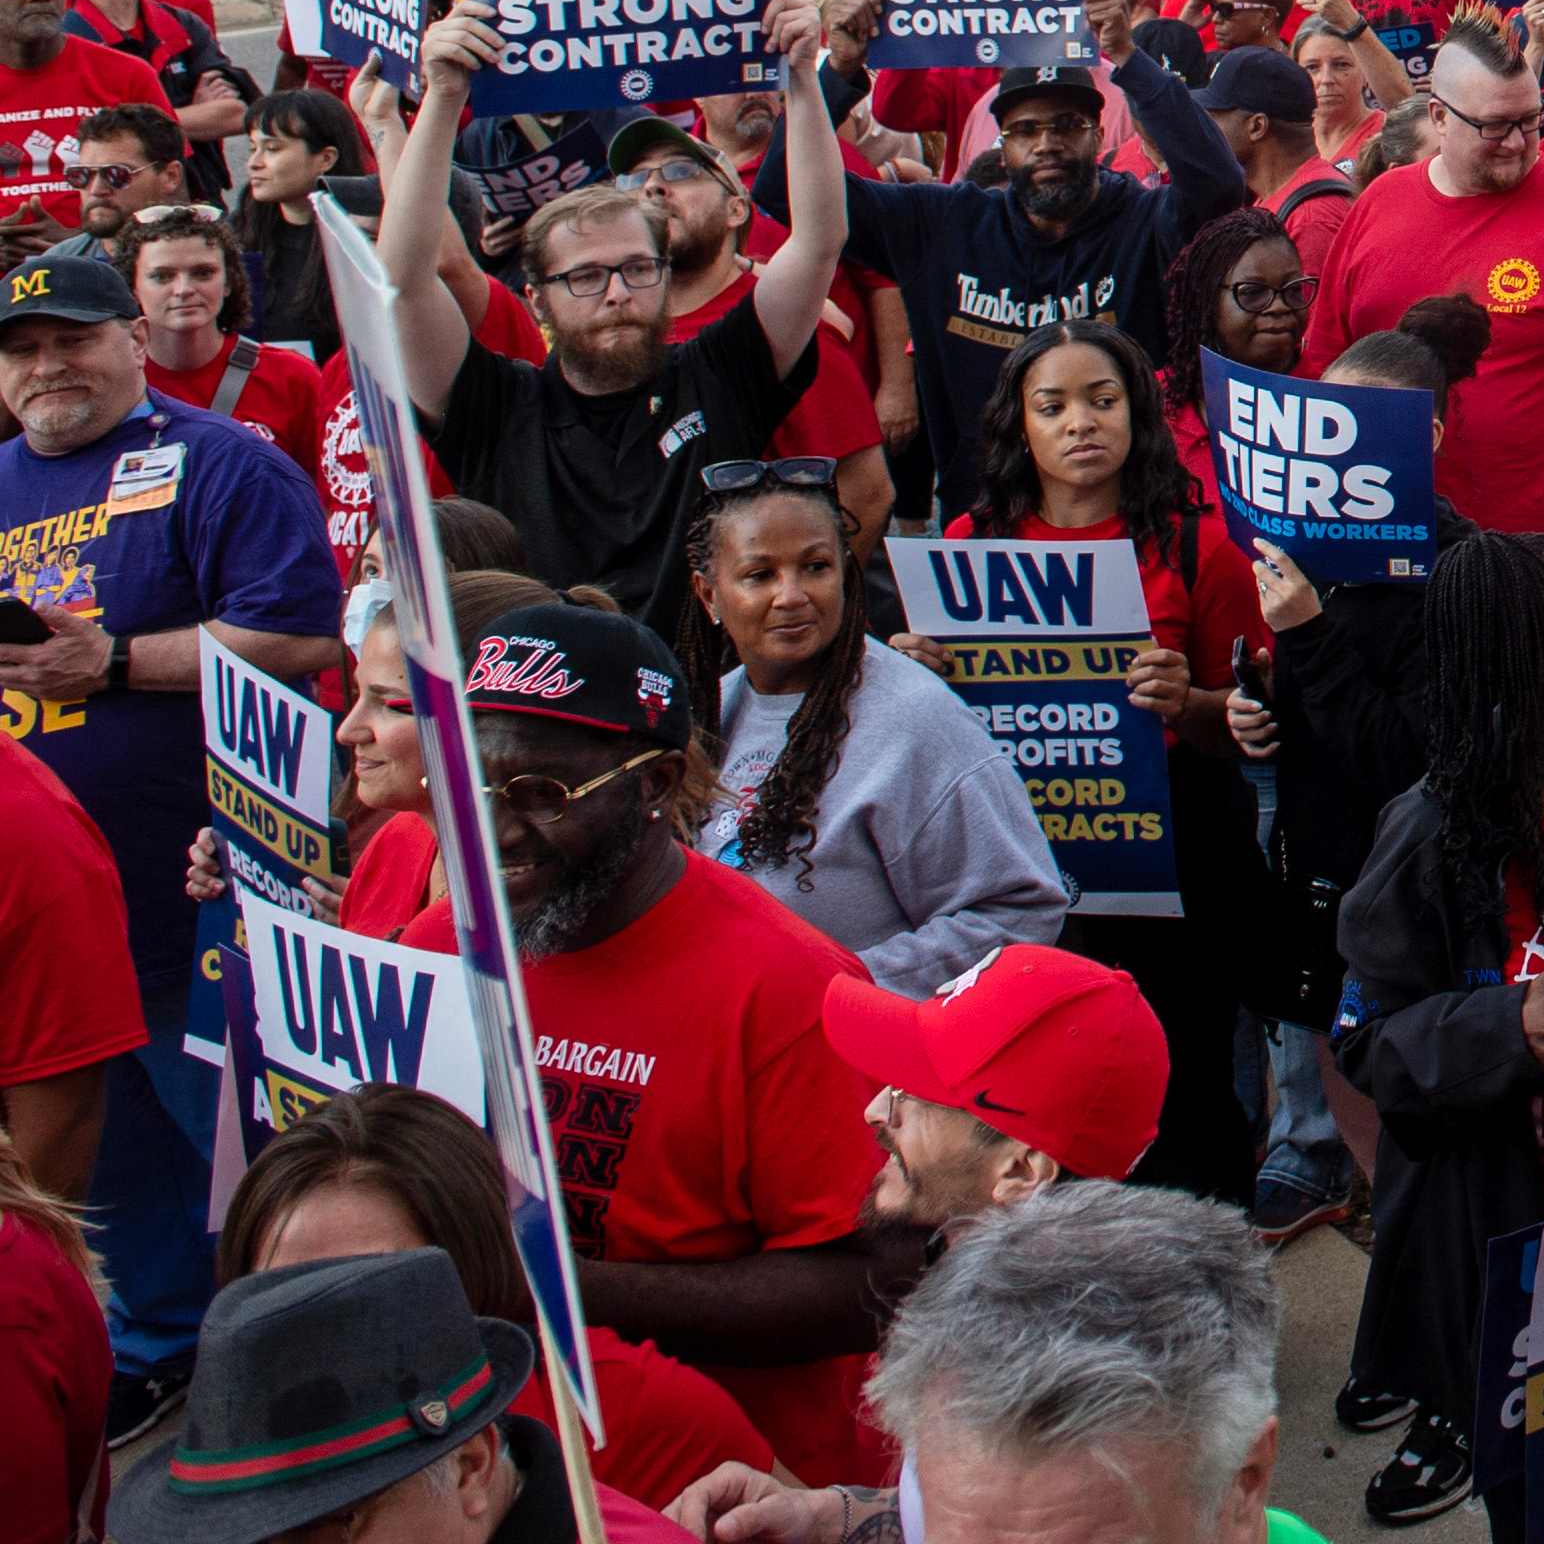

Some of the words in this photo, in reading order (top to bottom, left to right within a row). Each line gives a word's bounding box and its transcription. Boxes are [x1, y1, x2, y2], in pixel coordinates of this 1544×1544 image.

[497, 21, 763, 75] CONTRACT
[888, 7, 1081, 36] CONTRACT
[11, 269, 51, 304] M
[1486, 302, 1513, 313] Local
[1515, 303, 1527, 313] 12
[1228, 378, 1358, 456] END
[1219, 431, 1395, 519] TIERS
[928, 551, 1094, 626] UAW
[465, 636, 585, 699] Bulls
[510, 636, 555, 651] CHICAGO
[637, 667, 672, 688] CHICAGO
[641, 679, 668, 696] BULLS
[215, 656, 306, 798] UAW
[974, 703, 1119, 732] RECORD
[211, 769, 279, 845] STAND
[285, 822, 320, 866] UP
[227, 840, 312, 918] RECORD
[273, 924, 435, 1089] UAW
[534, 1035, 655, 1085] BARGAIN
